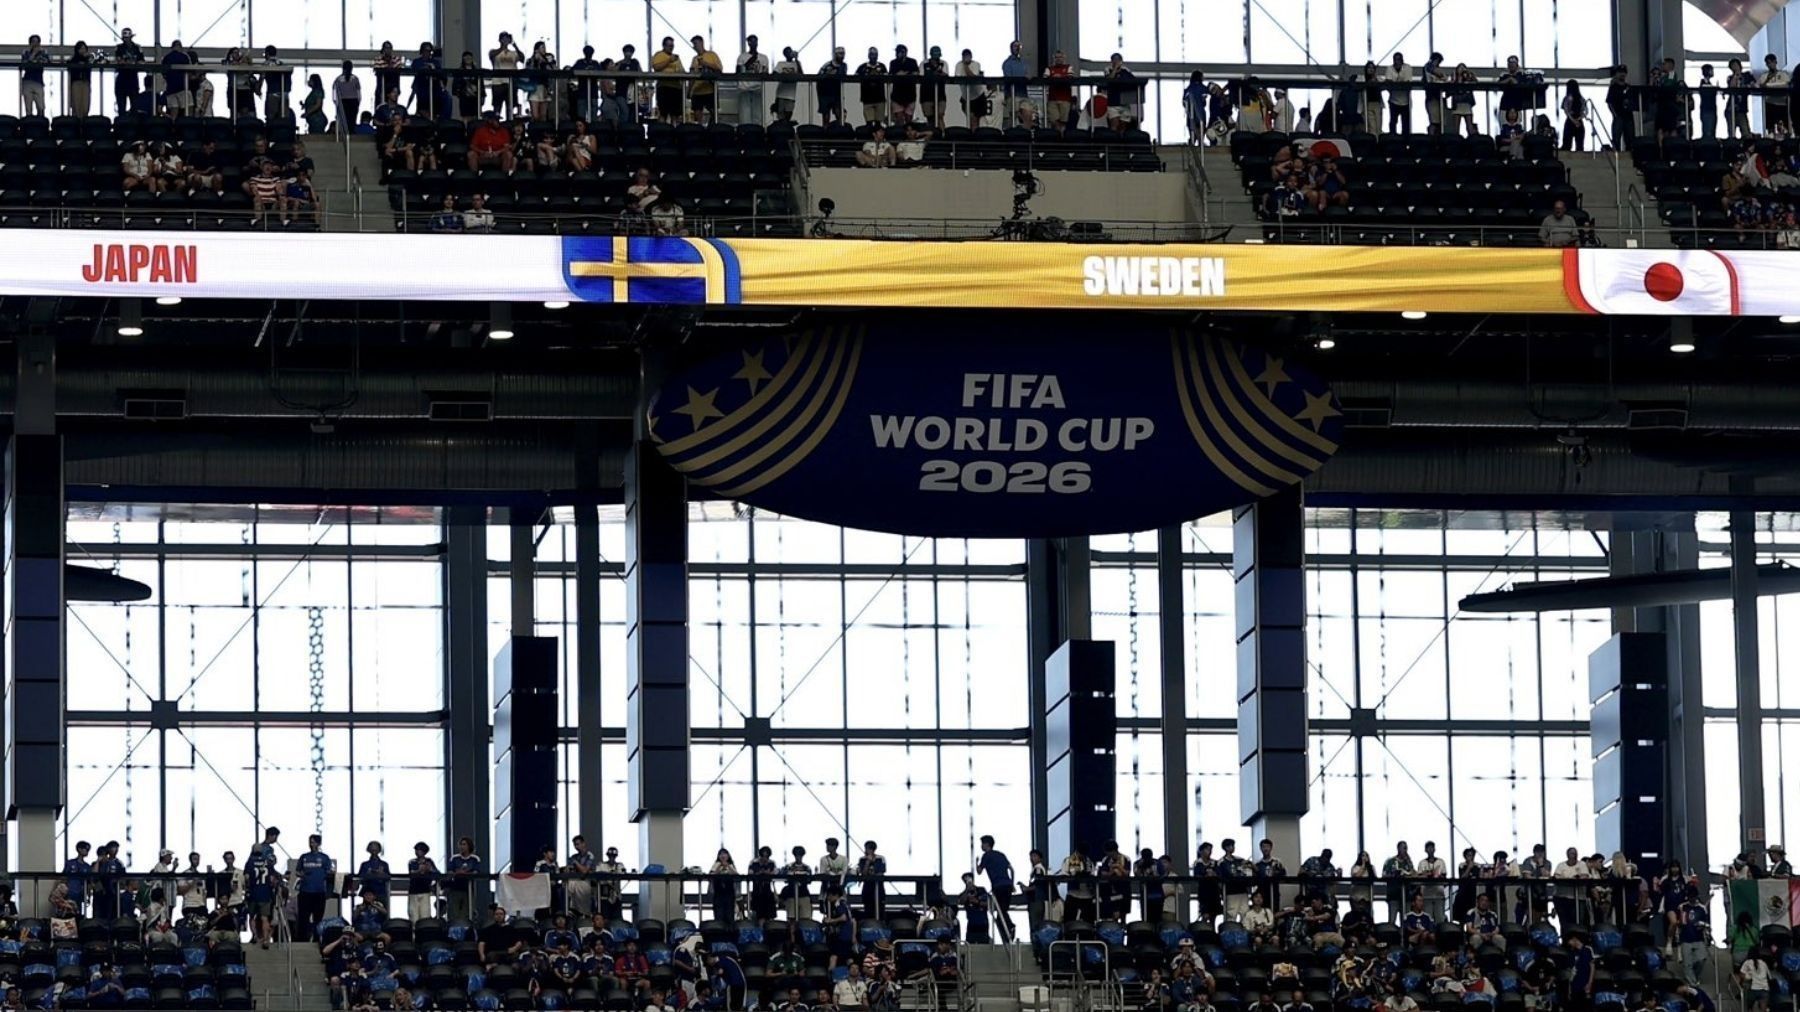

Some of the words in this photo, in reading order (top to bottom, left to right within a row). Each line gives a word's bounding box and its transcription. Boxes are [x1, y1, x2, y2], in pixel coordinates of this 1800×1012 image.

[82, 244, 197, 283] JAPAN
[1083, 255, 1226, 297] SWEDEN
[962, 373, 1066, 409] FIFA
[870, 414, 1049, 451] WORLD
[1058, 417, 1155, 452] CUP
[919, 459, 1092, 494] 2026
